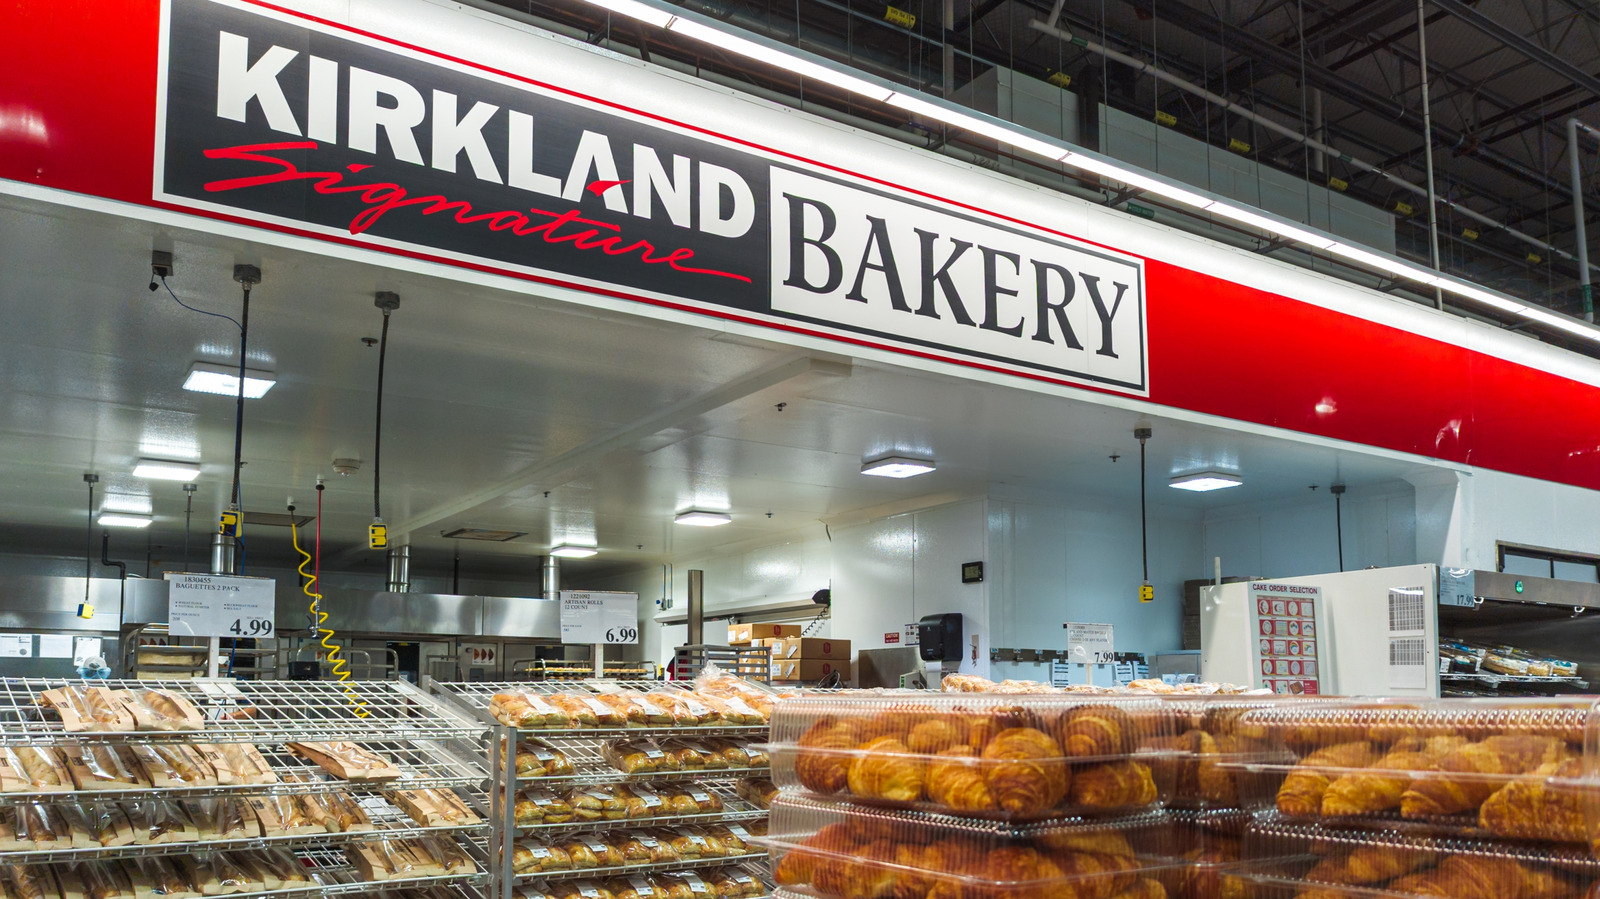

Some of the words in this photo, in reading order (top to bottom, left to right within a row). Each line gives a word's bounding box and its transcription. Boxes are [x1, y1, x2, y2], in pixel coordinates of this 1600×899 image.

[216, 30, 756, 239] KIRKLAND
[203, 141, 752, 284] Signature
[782, 192, 1129, 360] BAKERY
[175, 582, 216, 591] BAGUETTES
[1252, 583, 1267, 592] CAKE
[1269, 585, 1288, 593] ORDER
[1289, 586, 1318, 594] SELECTION
[1456, 594, 1474, 606] 17.99
[230, 618, 273, 636] 4.99
[606, 628, 637, 643] 6.99
[1094, 652, 1114, 663] 7.99
